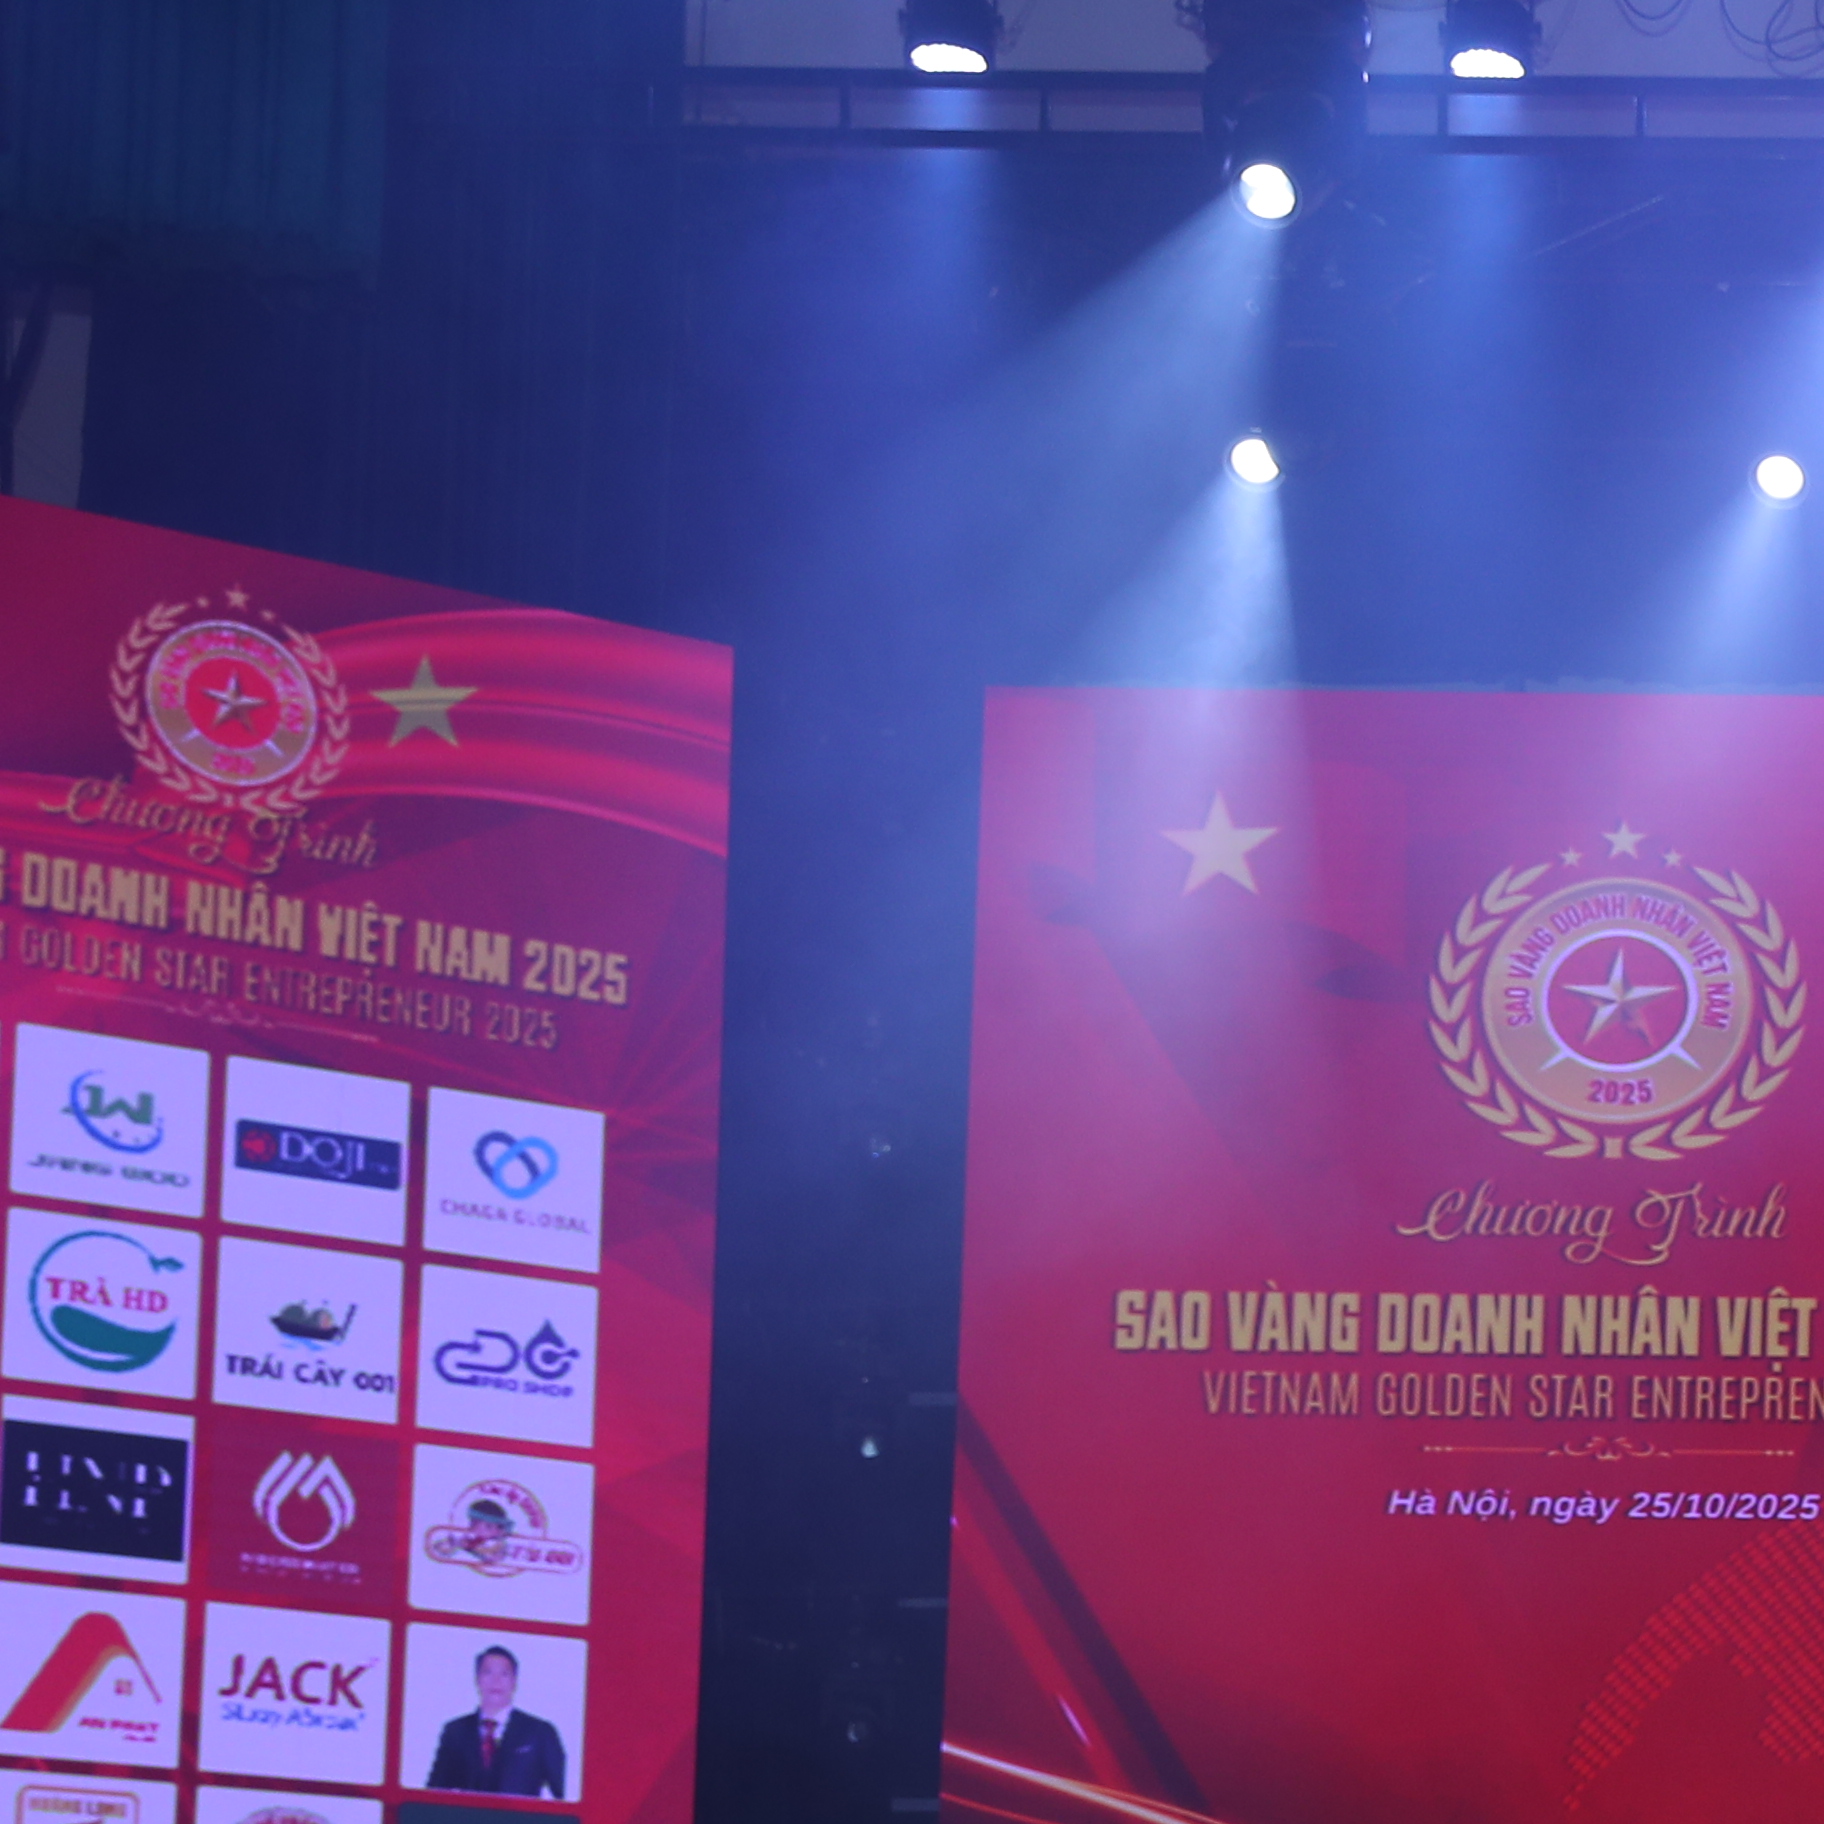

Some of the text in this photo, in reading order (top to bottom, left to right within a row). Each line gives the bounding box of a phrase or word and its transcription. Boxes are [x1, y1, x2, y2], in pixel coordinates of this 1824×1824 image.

[22, 851, 169, 929] DOANH
[186, 877, 302, 952] NHÂN
[318, 899, 402, 966] VIỆT
[415, 922, 511, 987] NAM
[523, 938, 630, 1005] 2025
[21, 925, 142, 982] GOLDEN
[155, 947, 228, 995] STAR
[246, 961, 472, 1037] ENTREPRENEUR
[484, 1001, 559, 1051] 2025
[1588, 1078, 1654, 1105] 2025
[279, 1130, 366, 1180] DOJI
[1396, 1179, 1789, 1264] Chương Trình
[46, 1274, 169, 1314] TRÀ HD
[1116, 1289, 1211, 1351] SAO
[1228, 1280, 1360, 1353] VÀNG
[1378, 1292, 1544, 1355] DOANH
[1562, 1286, 1699, 1356] NHÂN
[1718, 1286, 1815, 1373] VIỆT
[225, 1351, 396, 1395] TRÁI CÂY 001
[1202, 1370, 1360, 1417] VIETNAM
[1376, 1370, 1512, 1418] GOLDEN
[1528, 1372, 1614, 1419] STAR
[1388, 1486, 1821, 1524] Hà Nội, ngày 25/10/2025
[217, 1653, 369, 1710] JACK
